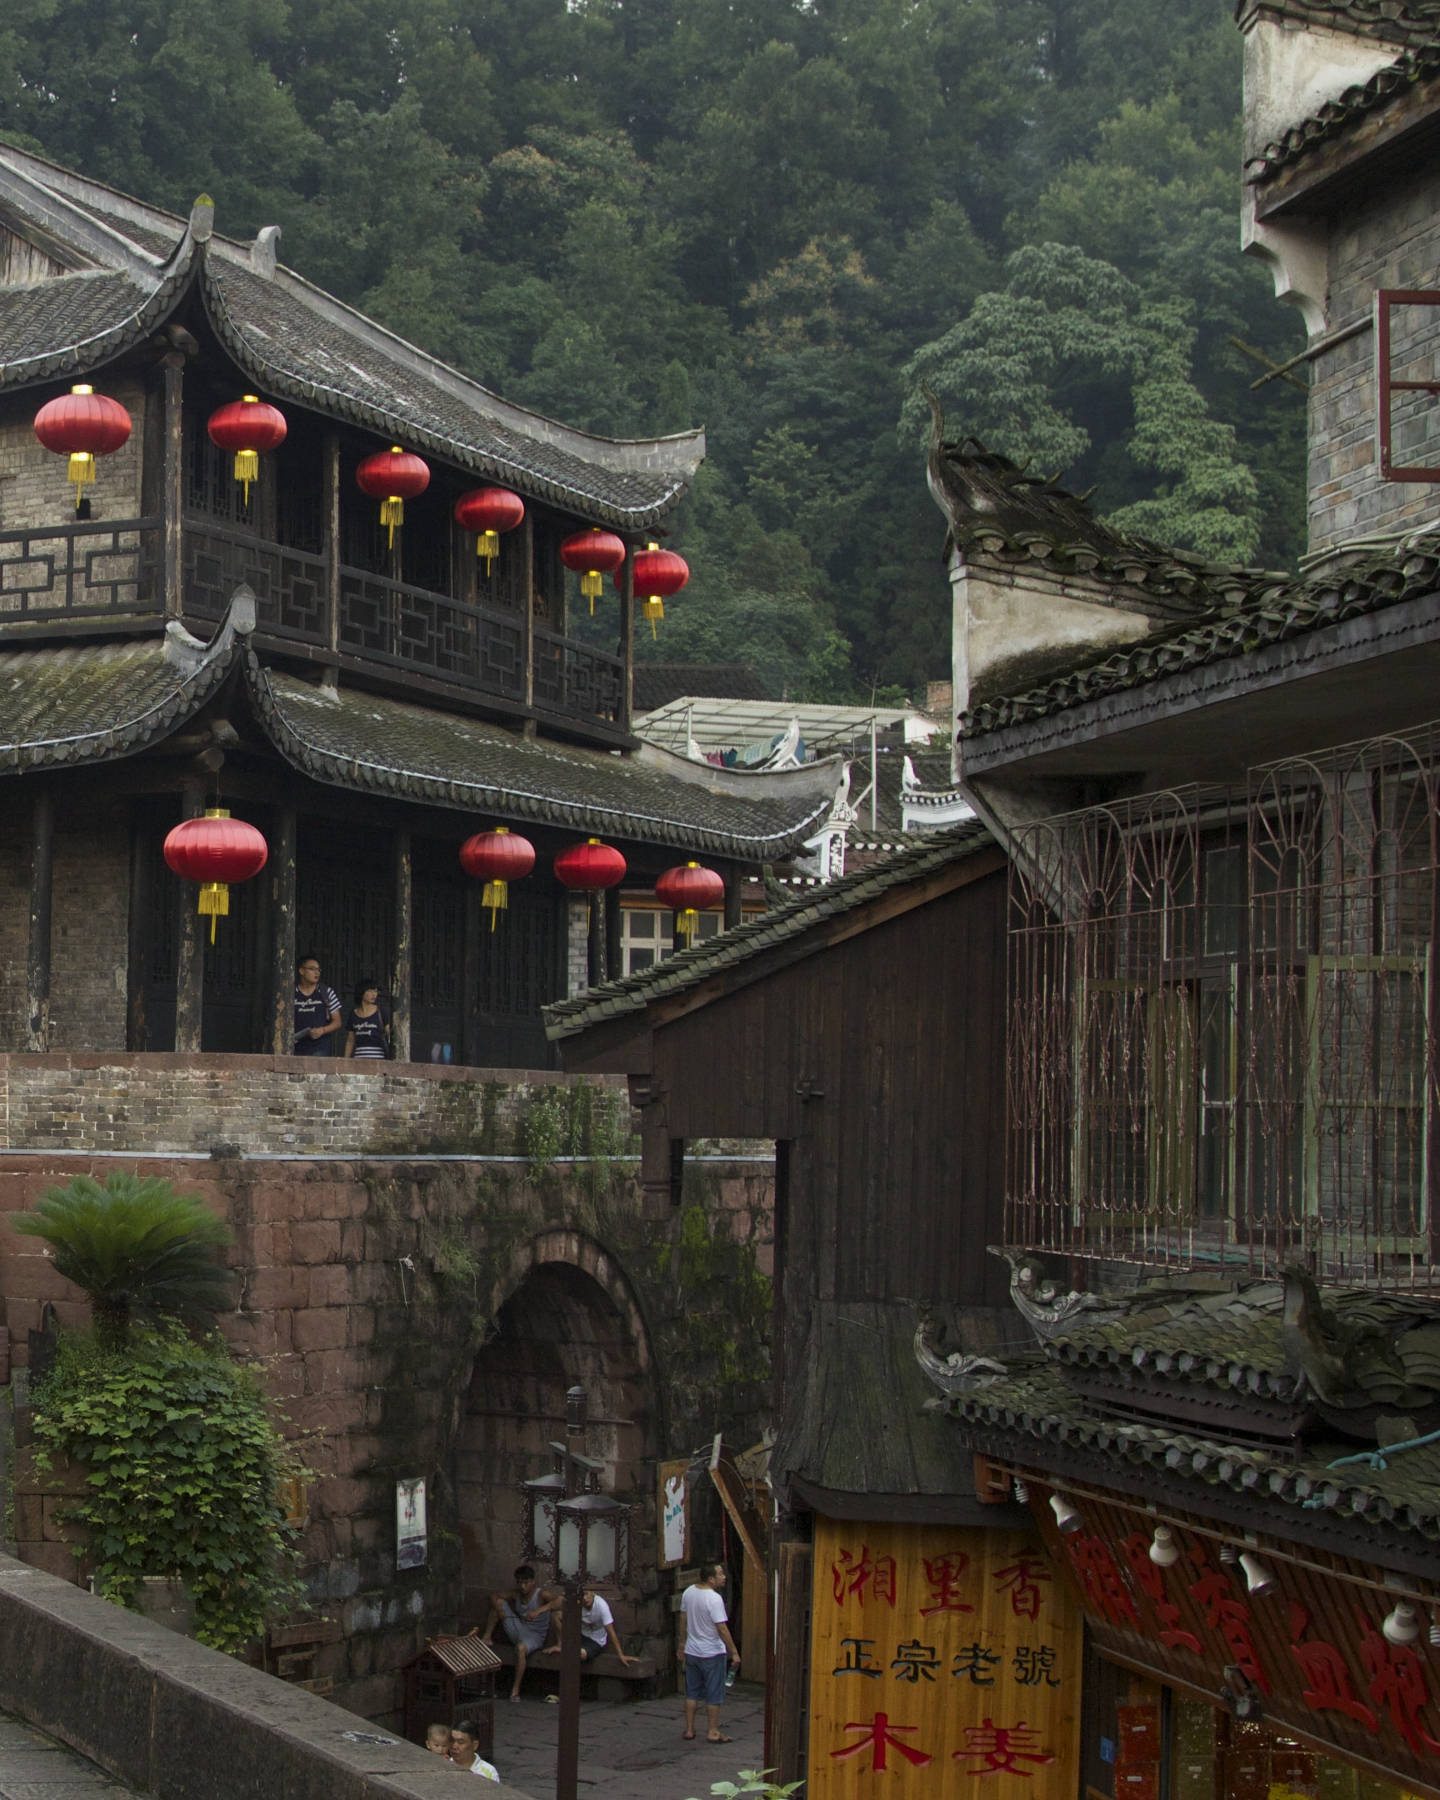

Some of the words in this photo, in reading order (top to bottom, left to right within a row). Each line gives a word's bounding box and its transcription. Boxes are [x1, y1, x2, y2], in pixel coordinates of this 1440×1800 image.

[831, 1544, 1054, 1624] 湘里香
[832, 1637, 1061, 1688] 正宗老號
[829, 1711, 1056, 1778] 木姜
